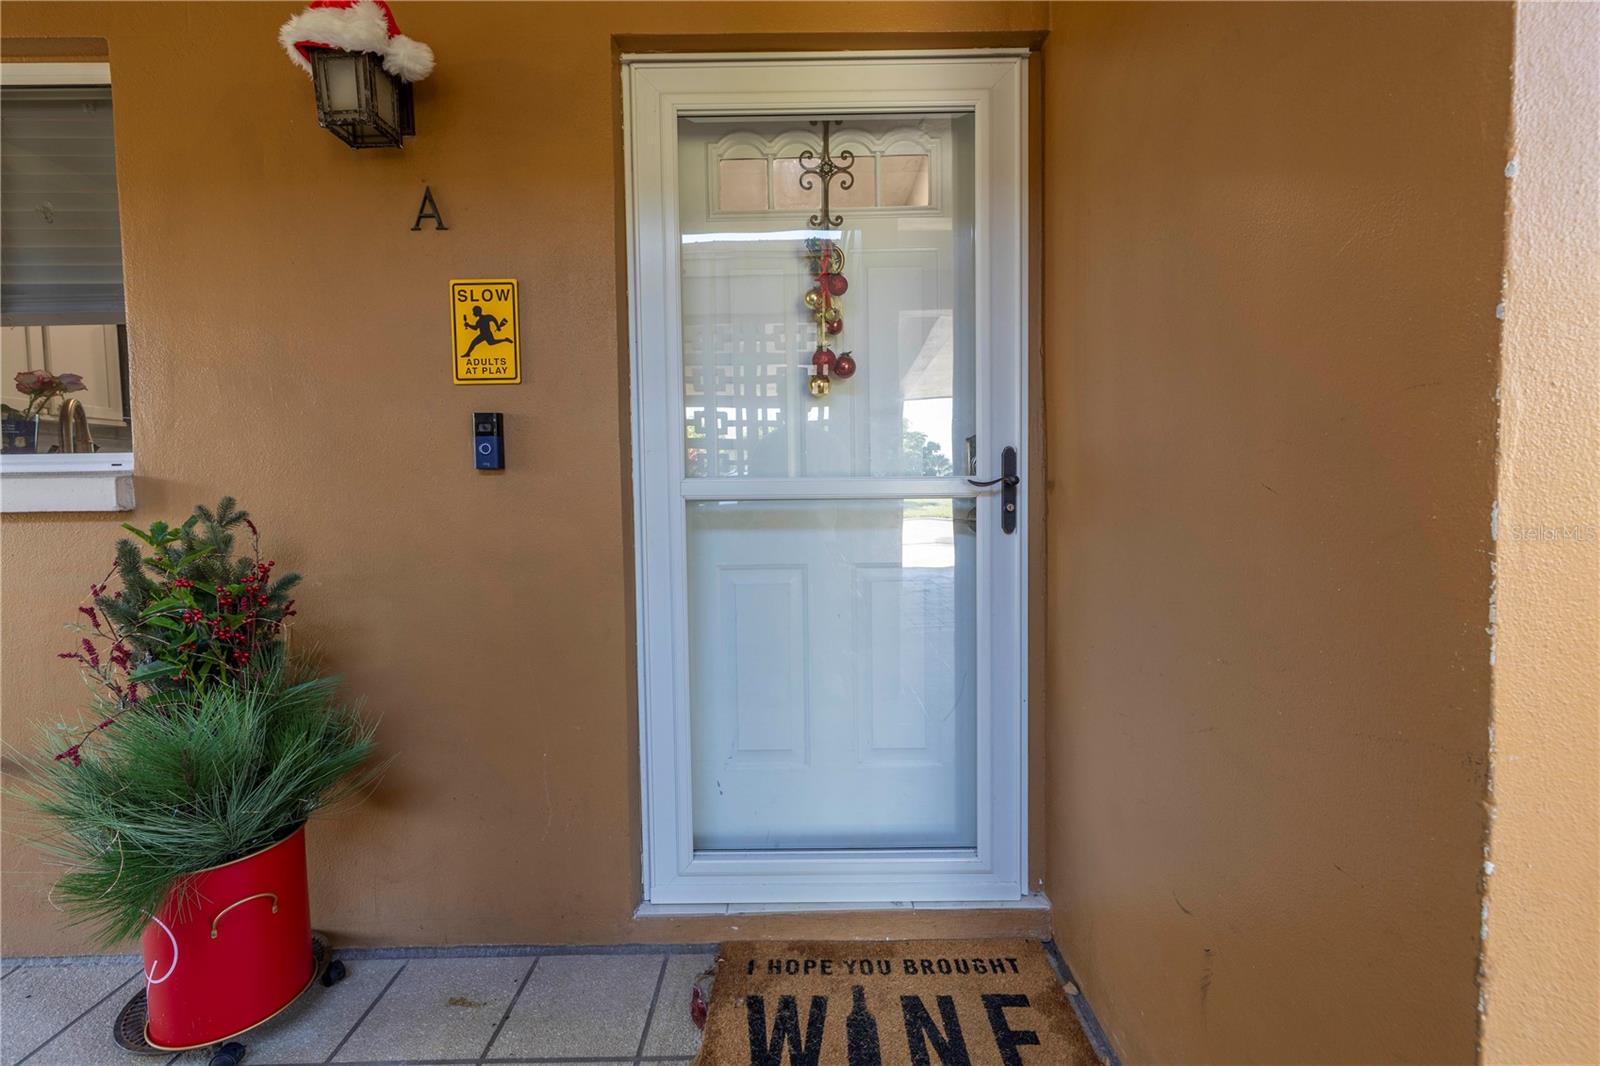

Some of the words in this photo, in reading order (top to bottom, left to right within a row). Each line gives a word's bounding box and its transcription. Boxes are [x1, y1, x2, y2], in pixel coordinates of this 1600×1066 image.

[410, 186, 449, 231] A
[457, 288, 511, 303] SLOW
[465, 358, 508, 367] ADULTS
[465, 367, 478, 375] AT
[481, 366, 508, 375] PLAY
[746, 959, 755, 975] I
[767, 959, 834, 975] HOPE
[843, 959, 892, 975] YOU
[903, 957, 1020, 975] BROUGHT
